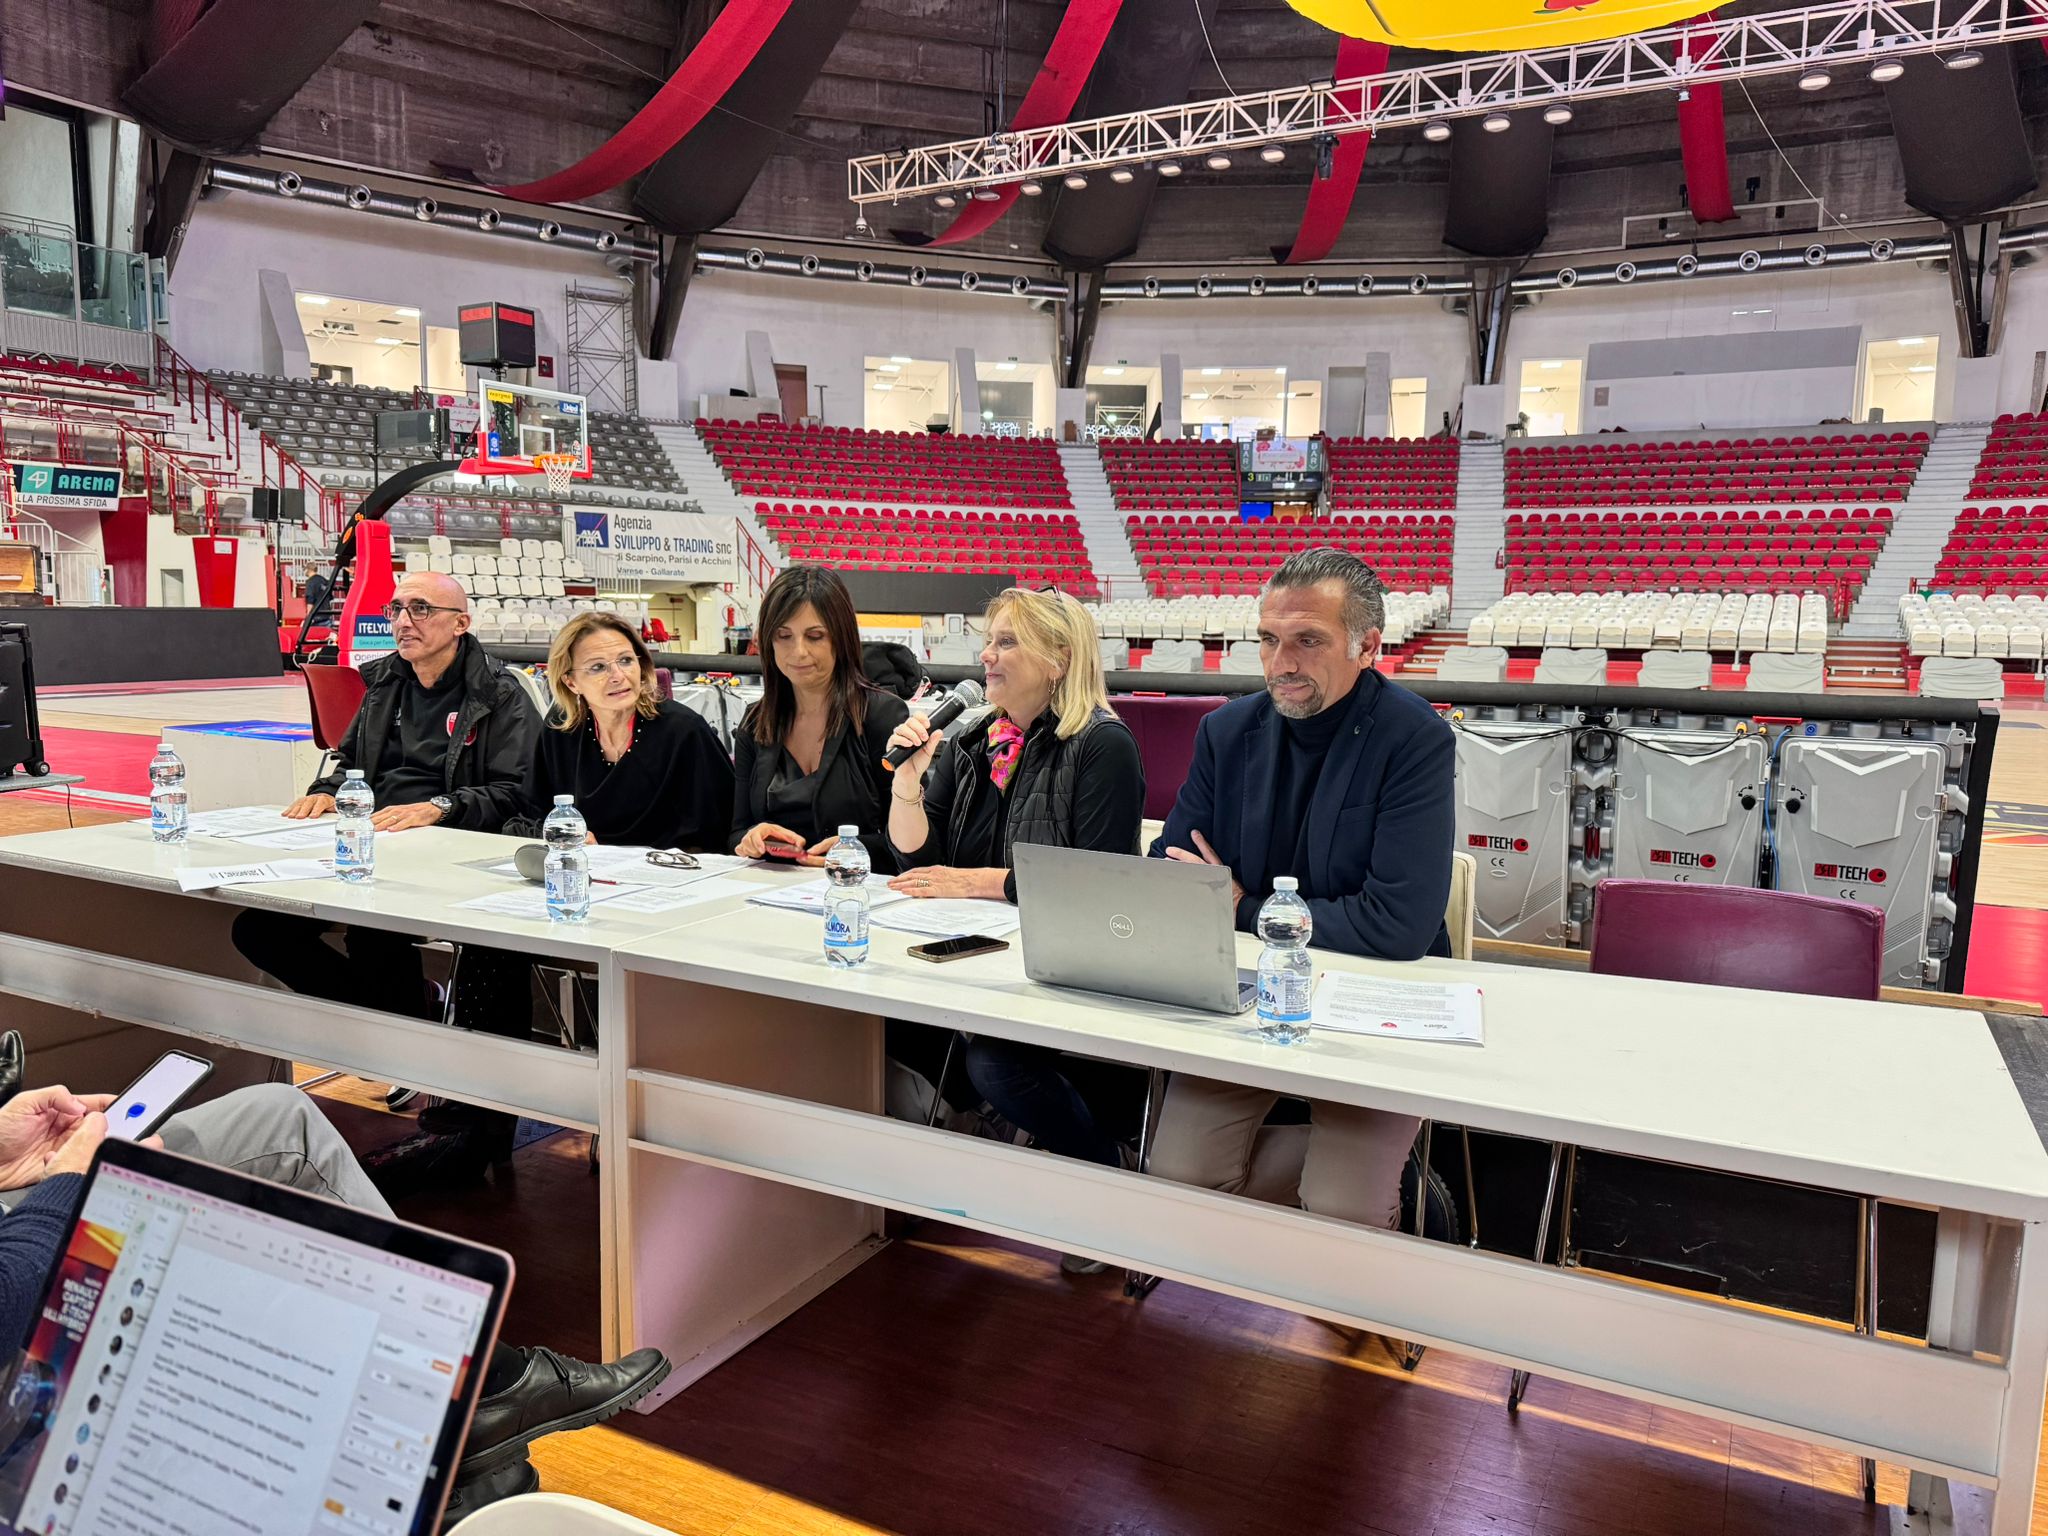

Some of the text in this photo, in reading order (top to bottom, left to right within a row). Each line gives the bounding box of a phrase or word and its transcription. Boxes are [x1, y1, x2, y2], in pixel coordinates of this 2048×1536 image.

[1242, 443, 1250, 465] BAR
[1310, 442, 1318, 465] BAR
[57, 474, 115, 492] ARENA
[1247, 472, 1254, 482] 3
[36, 495, 81, 506] PROSSIMA
[83, 497, 108, 508] SFIDA
[614, 514, 652, 532] Agenzia
[615, 534, 732, 555] SVILUPPO & TRADING snc
[624, 553, 667, 564] Scarpino,
[668, 554, 692, 564] Parisi
[701, 557, 732, 566] Acchini
[617, 567, 644, 575] Varese
[650, 567, 685, 577] Gallarate
[1488, 835, 1513, 850] TECH
[1671, 851, 1700, 867] TECH
[1838, 865, 1869, 881] TECH
[1112, 921, 1132, 931] DELL
